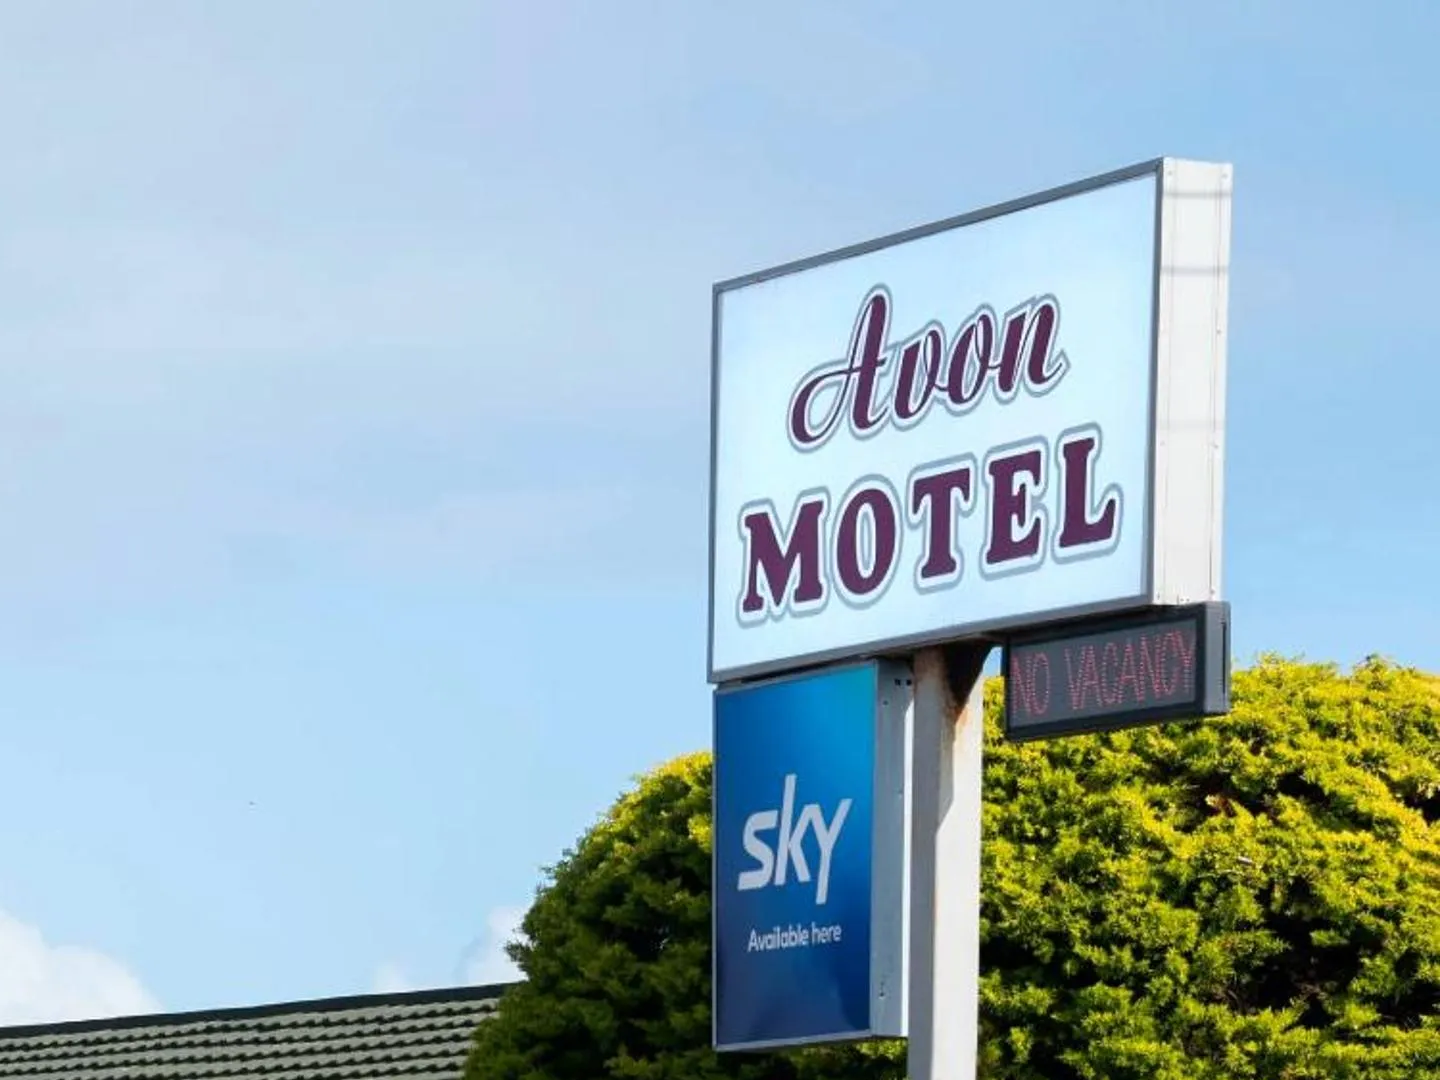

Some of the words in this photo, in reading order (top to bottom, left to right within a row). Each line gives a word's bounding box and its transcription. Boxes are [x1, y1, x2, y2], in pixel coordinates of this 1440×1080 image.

[789, 291, 1064, 444] Avon
[742, 437, 1116, 613] MOTEL
[1010, 652, 1050, 716] NO
[1066, 630, 1196, 710] VACANCY
[737, 773, 852, 905] sky
[747, 923, 809, 952] Available
[811, 920, 842, 945] here
